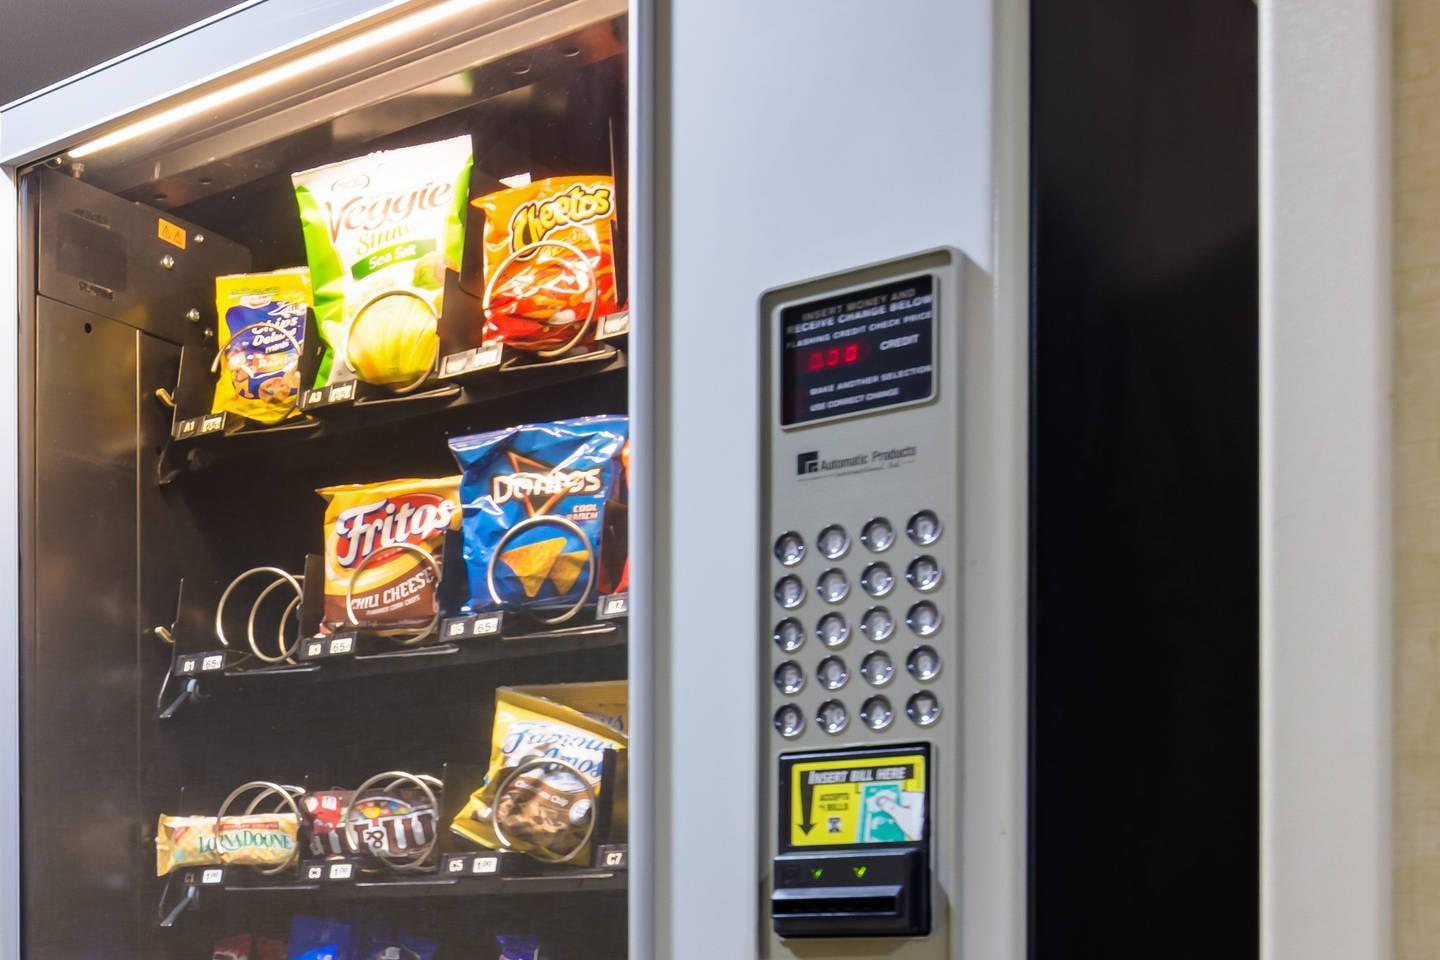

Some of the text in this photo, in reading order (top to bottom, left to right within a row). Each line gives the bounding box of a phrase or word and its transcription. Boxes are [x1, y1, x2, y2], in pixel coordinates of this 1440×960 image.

[325, 181, 451, 243] Veggie
[512, 186, 611, 258] Cheetos
[802, 288, 916, 321] INSERT MONEY AND
[837, 305, 887, 323] CHANGE
[889, 295, 933, 312] BELOW
[832, 326, 867, 339] CREDIT
[868, 318, 901, 331] CHECK
[879, 333, 920, 350] CREDIT
[810, 384, 834, 396] MAKE
[836, 376, 879, 390] ANOTHER
[821, 455, 869, 470] Automatic
[872, 446, 917, 462] Products
[336, 498, 456, 567] Fritos
[350, 566, 435, 610] CHILI CHEESE
[808, 766, 906, 784] INSERT BILL HERE
[449, 859, 464, 873] C5
[606, 852, 623, 866] C7
